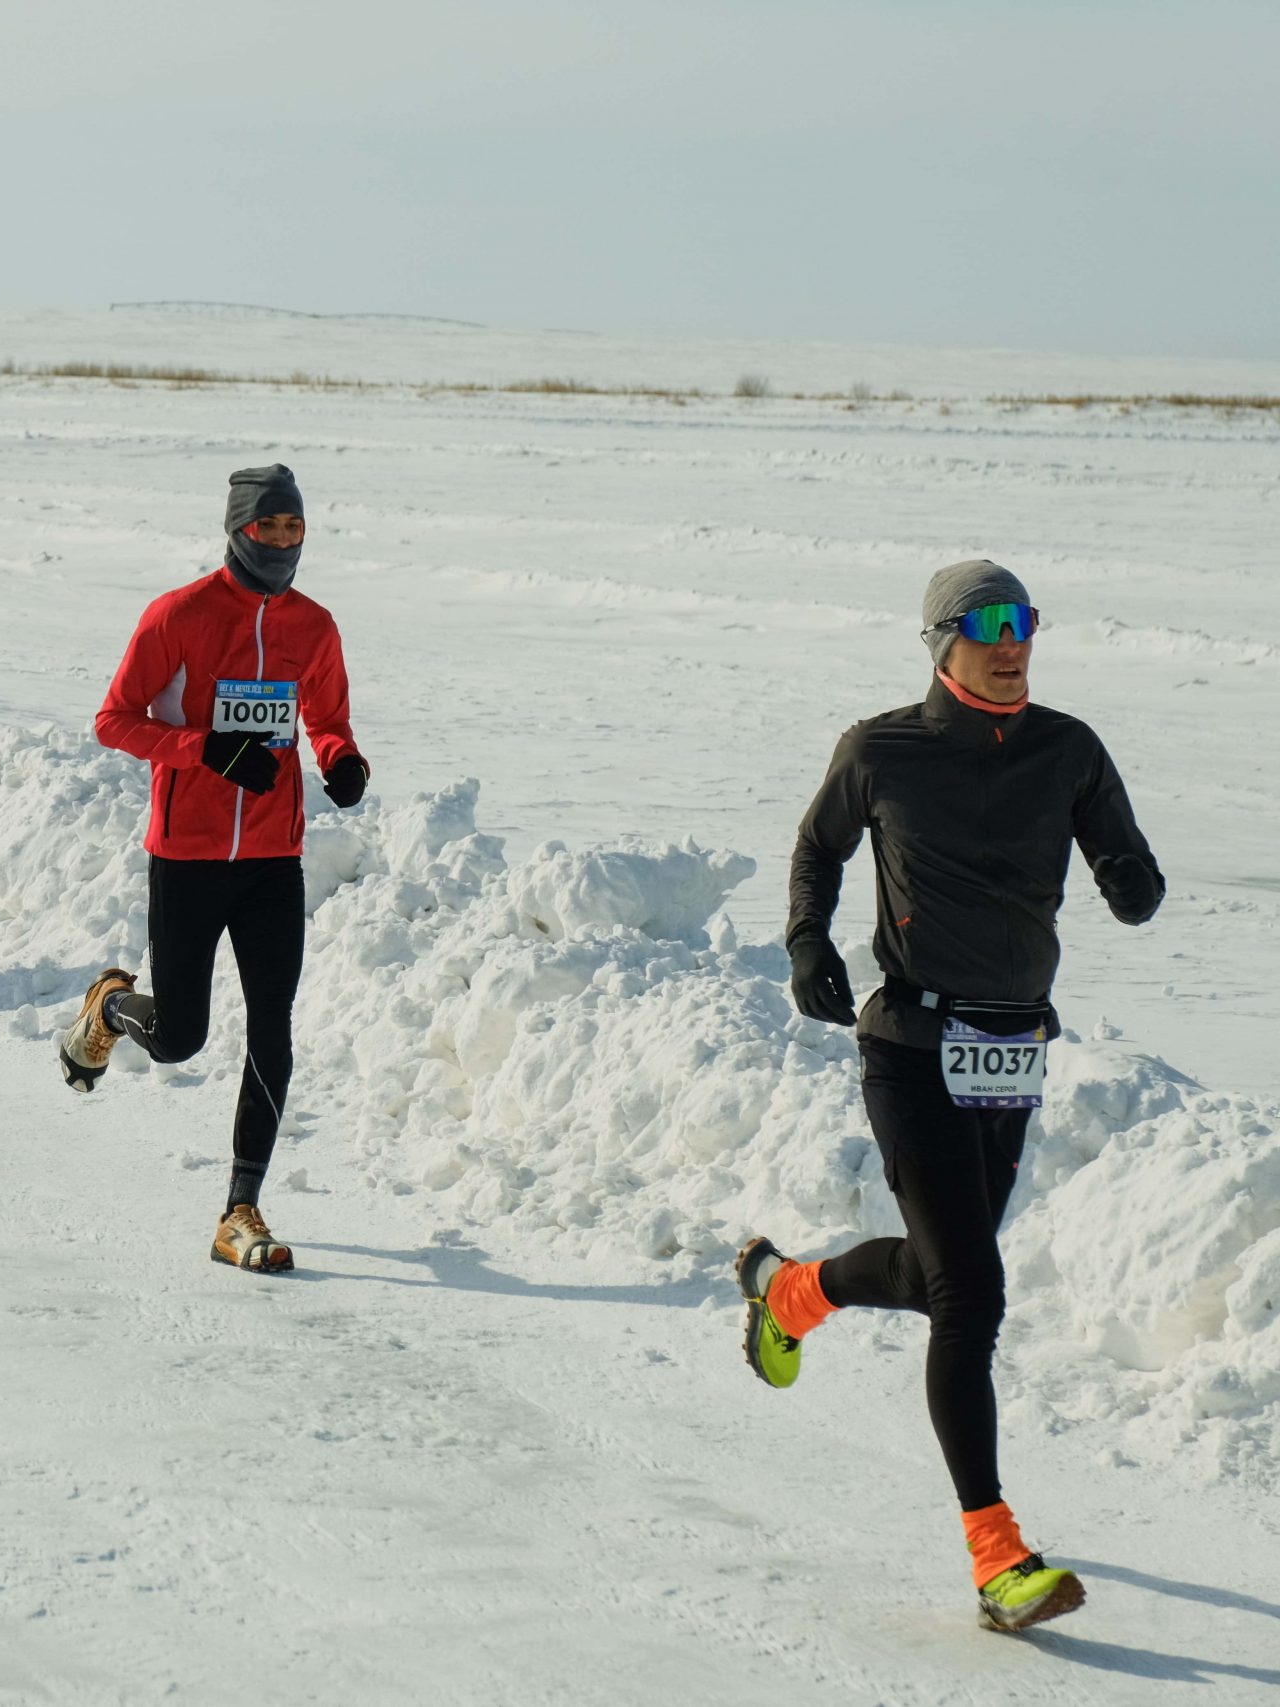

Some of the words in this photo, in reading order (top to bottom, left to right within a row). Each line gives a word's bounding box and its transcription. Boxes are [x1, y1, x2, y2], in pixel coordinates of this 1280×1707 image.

[221, 701, 290, 723] 10012
[948, 1046, 1038, 1075] 21037
[971, 1085, 993, 1093] ИВАН
[995, 1085, 1018, 1093] СЕРОВ
